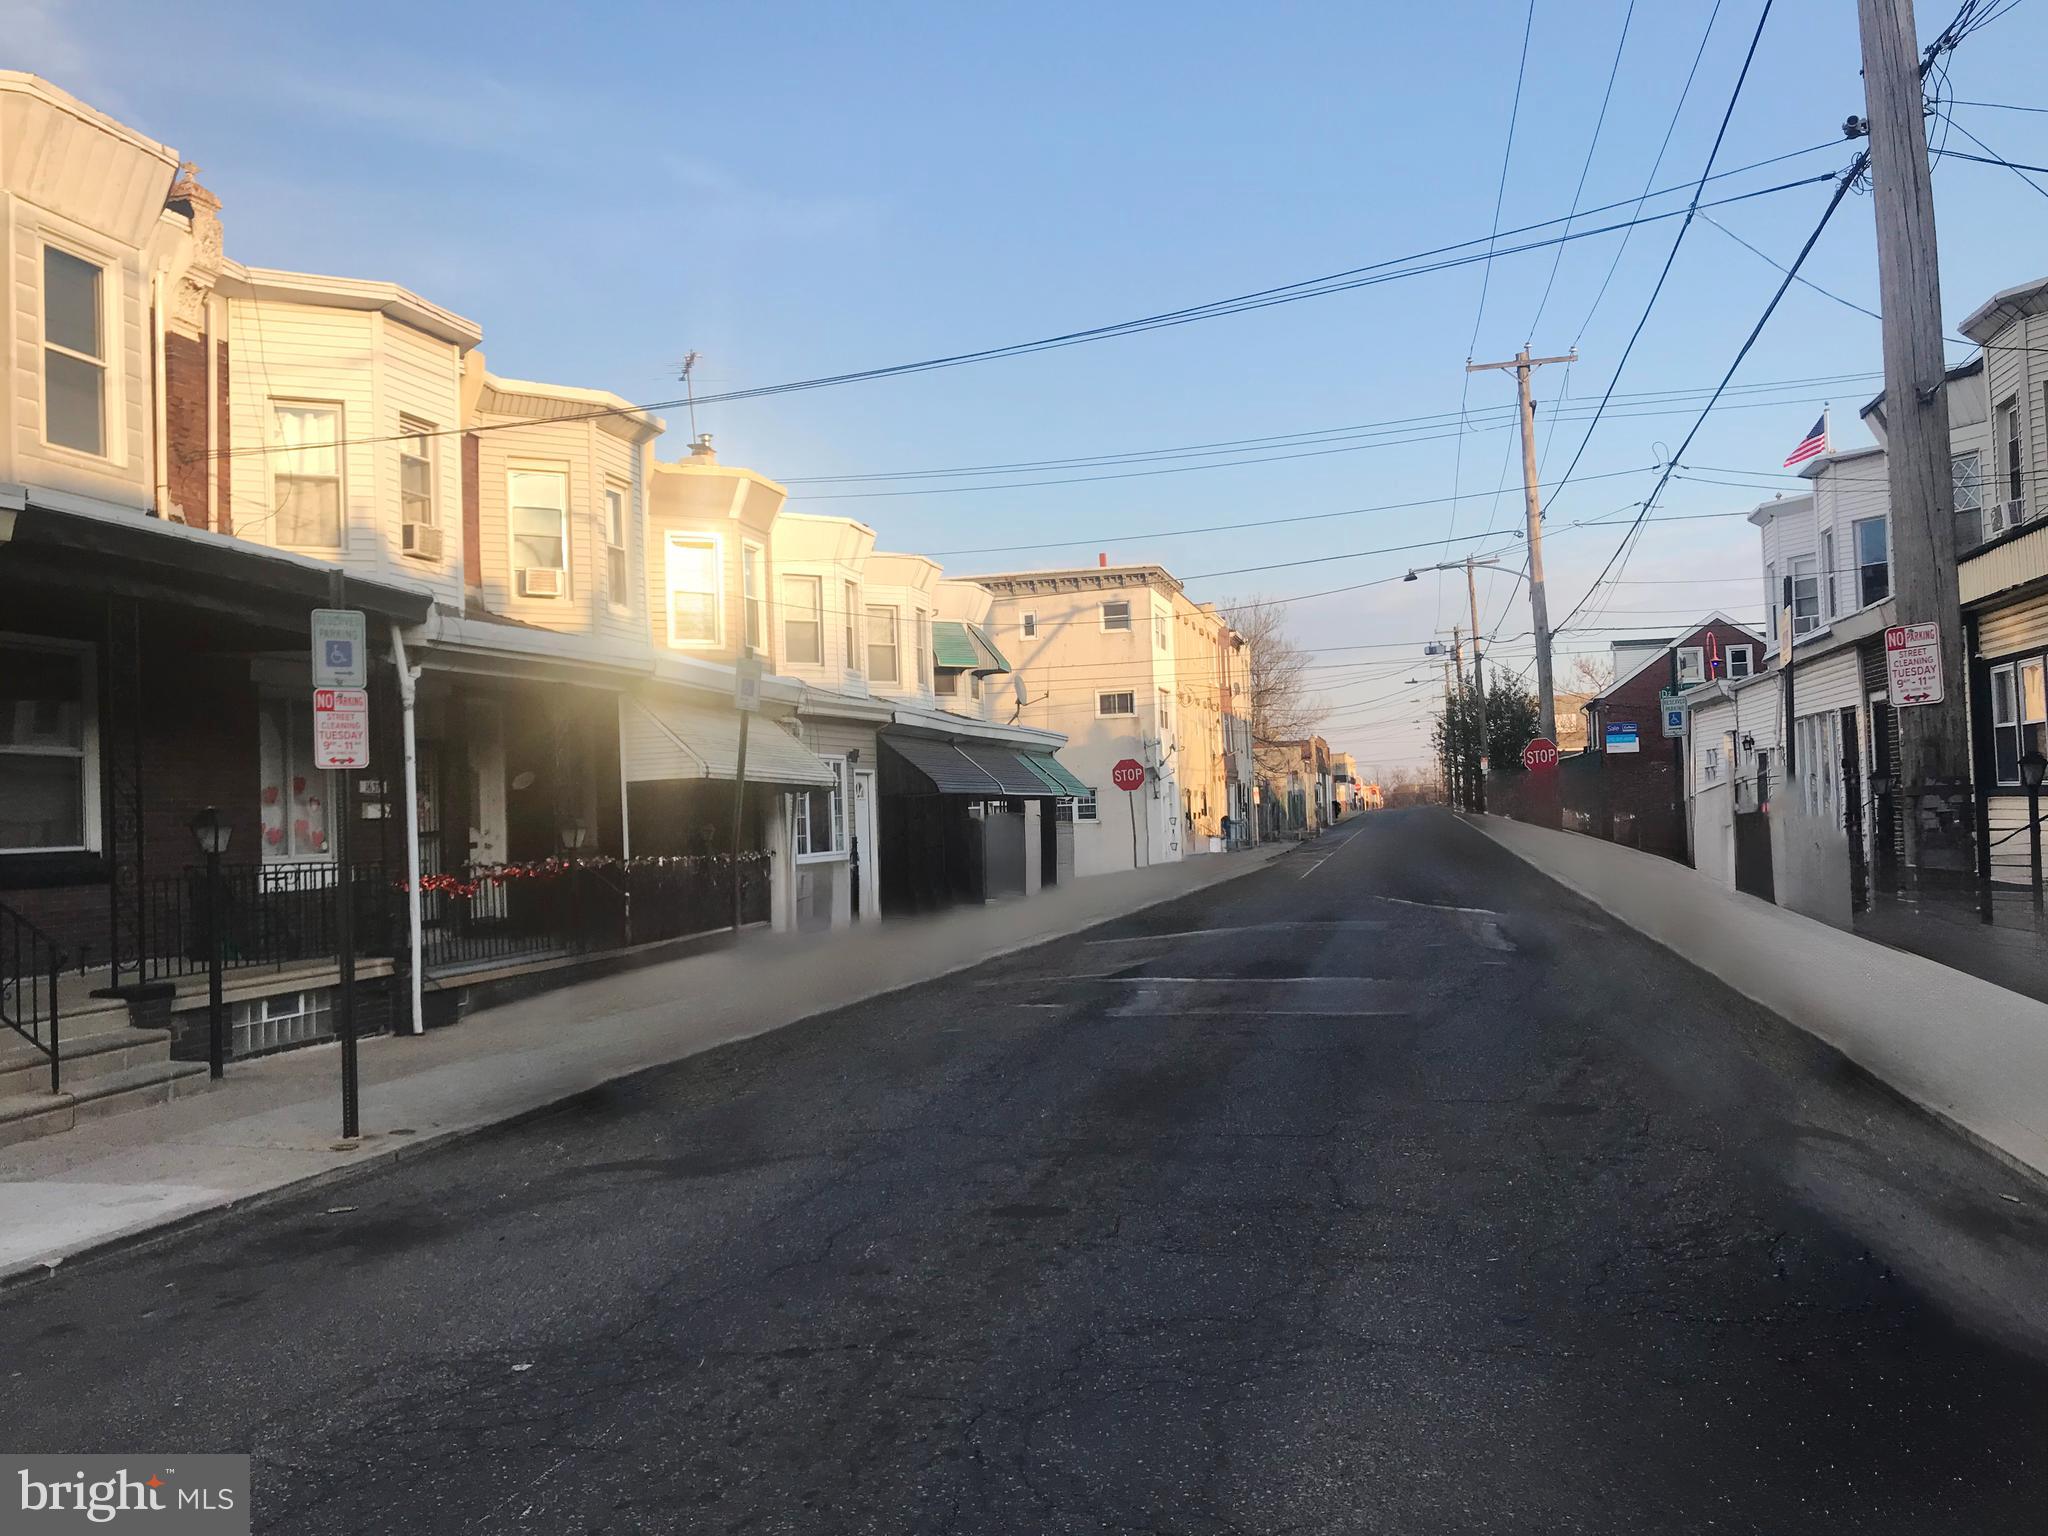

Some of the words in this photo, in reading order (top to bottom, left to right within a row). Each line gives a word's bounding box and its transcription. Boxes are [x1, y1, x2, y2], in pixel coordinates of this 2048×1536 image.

[1888, 631, 1904, 648] NO
[1906, 630, 1935, 643] PARKING
[1899, 647, 1927, 659] STREET
[1893, 656, 1934, 667] CLEANING
[1891, 664, 1937, 678] TUESDAY
[316, 693, 334, 709] NO
[335, 696, 363, 706] PARKING
[326, 713, 356, 721] STREET
[321, 722, 361, 730] CLEANING
[319, 730, 364, 740] TUESDAY
[1527, 748, 1556, 765] STOP
[1114, 768, 1143, 782] STOP
